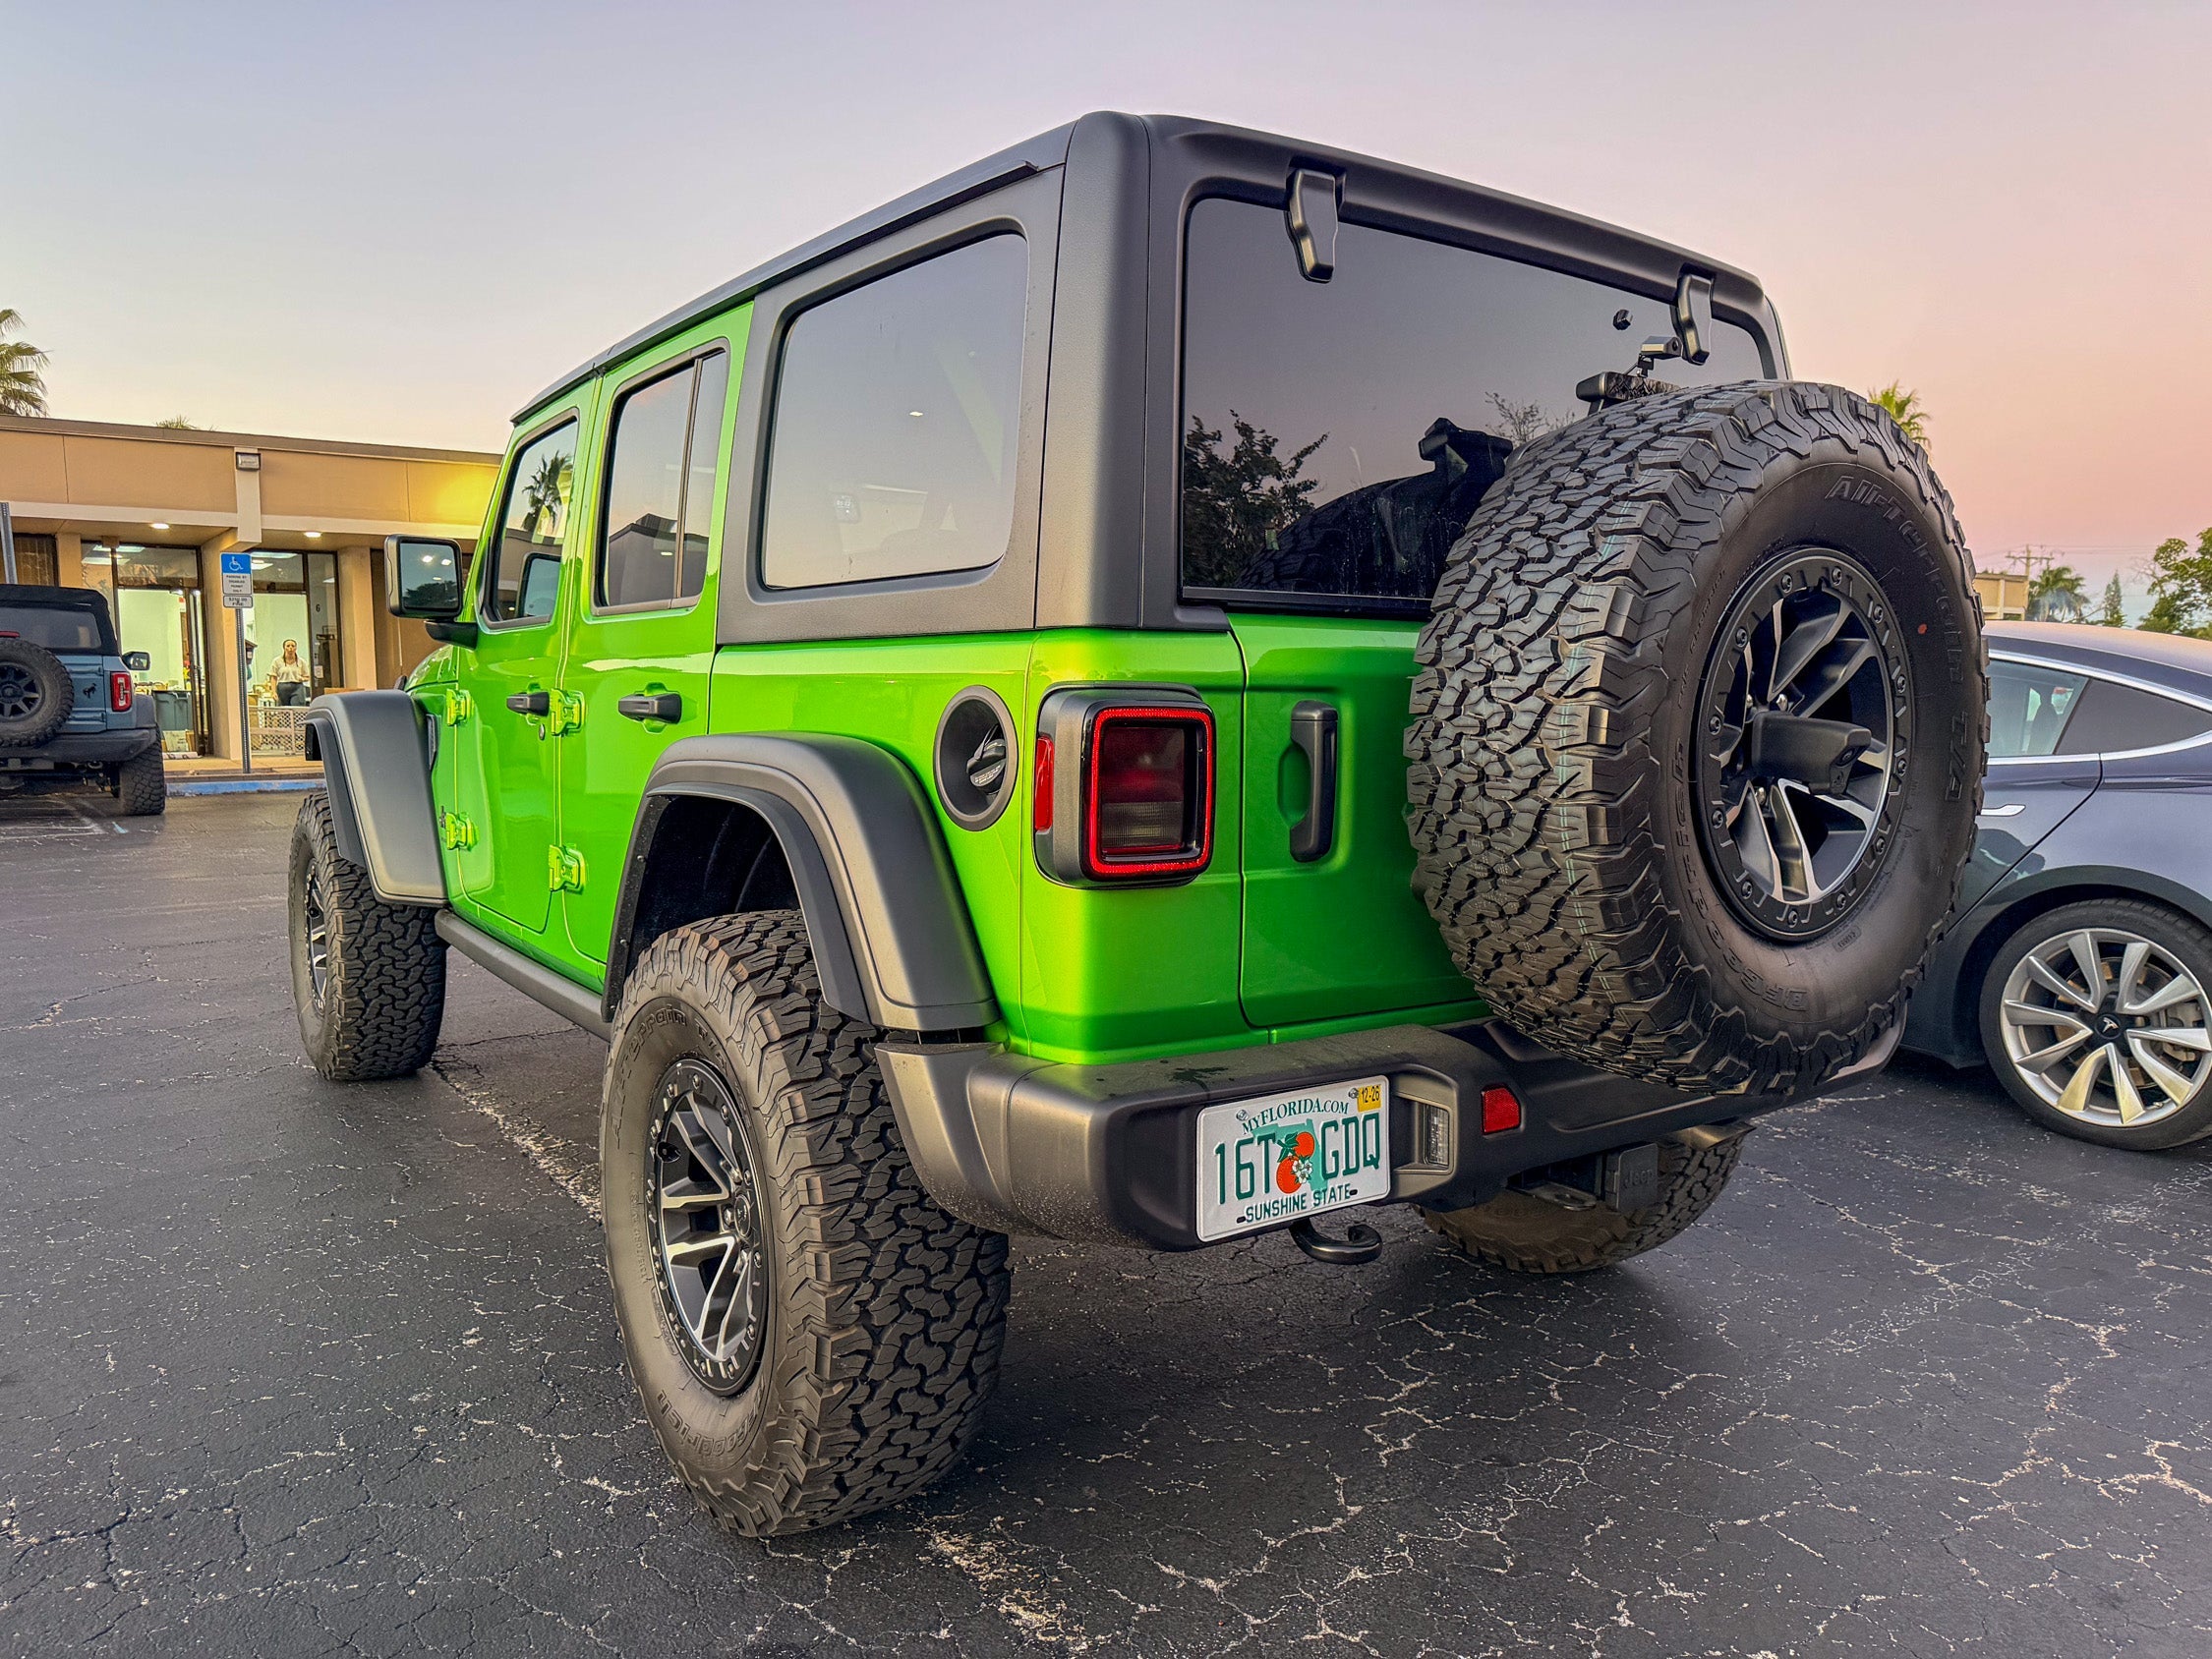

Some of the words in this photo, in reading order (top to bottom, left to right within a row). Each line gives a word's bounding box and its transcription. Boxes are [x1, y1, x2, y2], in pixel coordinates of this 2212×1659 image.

[316, 603, 320, 612] 6
[1361, 1085, 1381, 1104] 12-26
[1213, 1132, 1276, 1205] 16T
[1319, 1112, 1380, 1180] GDQ
[1623, 1169, 1655, 1189] Jeep
[1245, 1192, 1308, 1224] SUNSHINE
[1312, 1182, 1351, 1208] STATE
